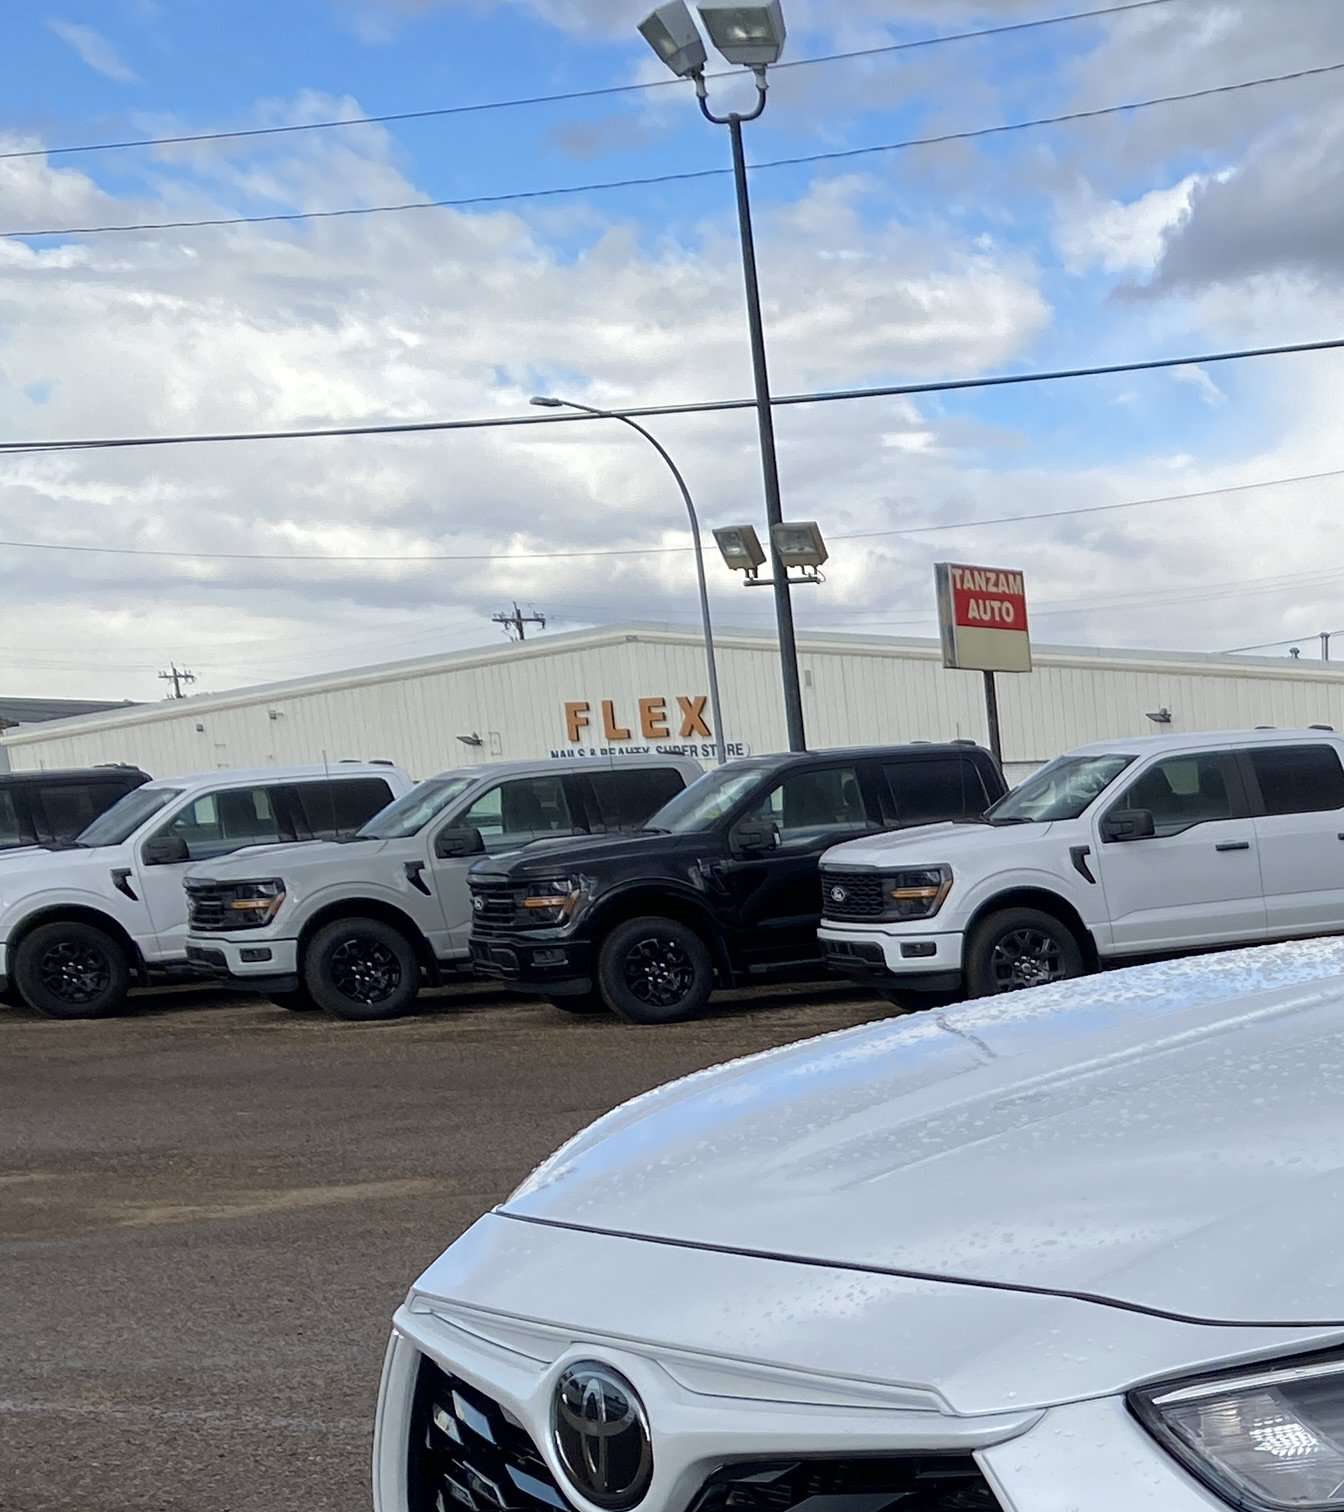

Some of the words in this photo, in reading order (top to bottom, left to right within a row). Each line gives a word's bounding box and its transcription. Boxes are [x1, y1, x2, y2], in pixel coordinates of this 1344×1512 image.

[952, 568, 1023, 595] TANZAM
[968, 599, 1014, 622] AUTO
[565, 696, 712, 742] FLEX
[701, 743, 744, 757] STRE
